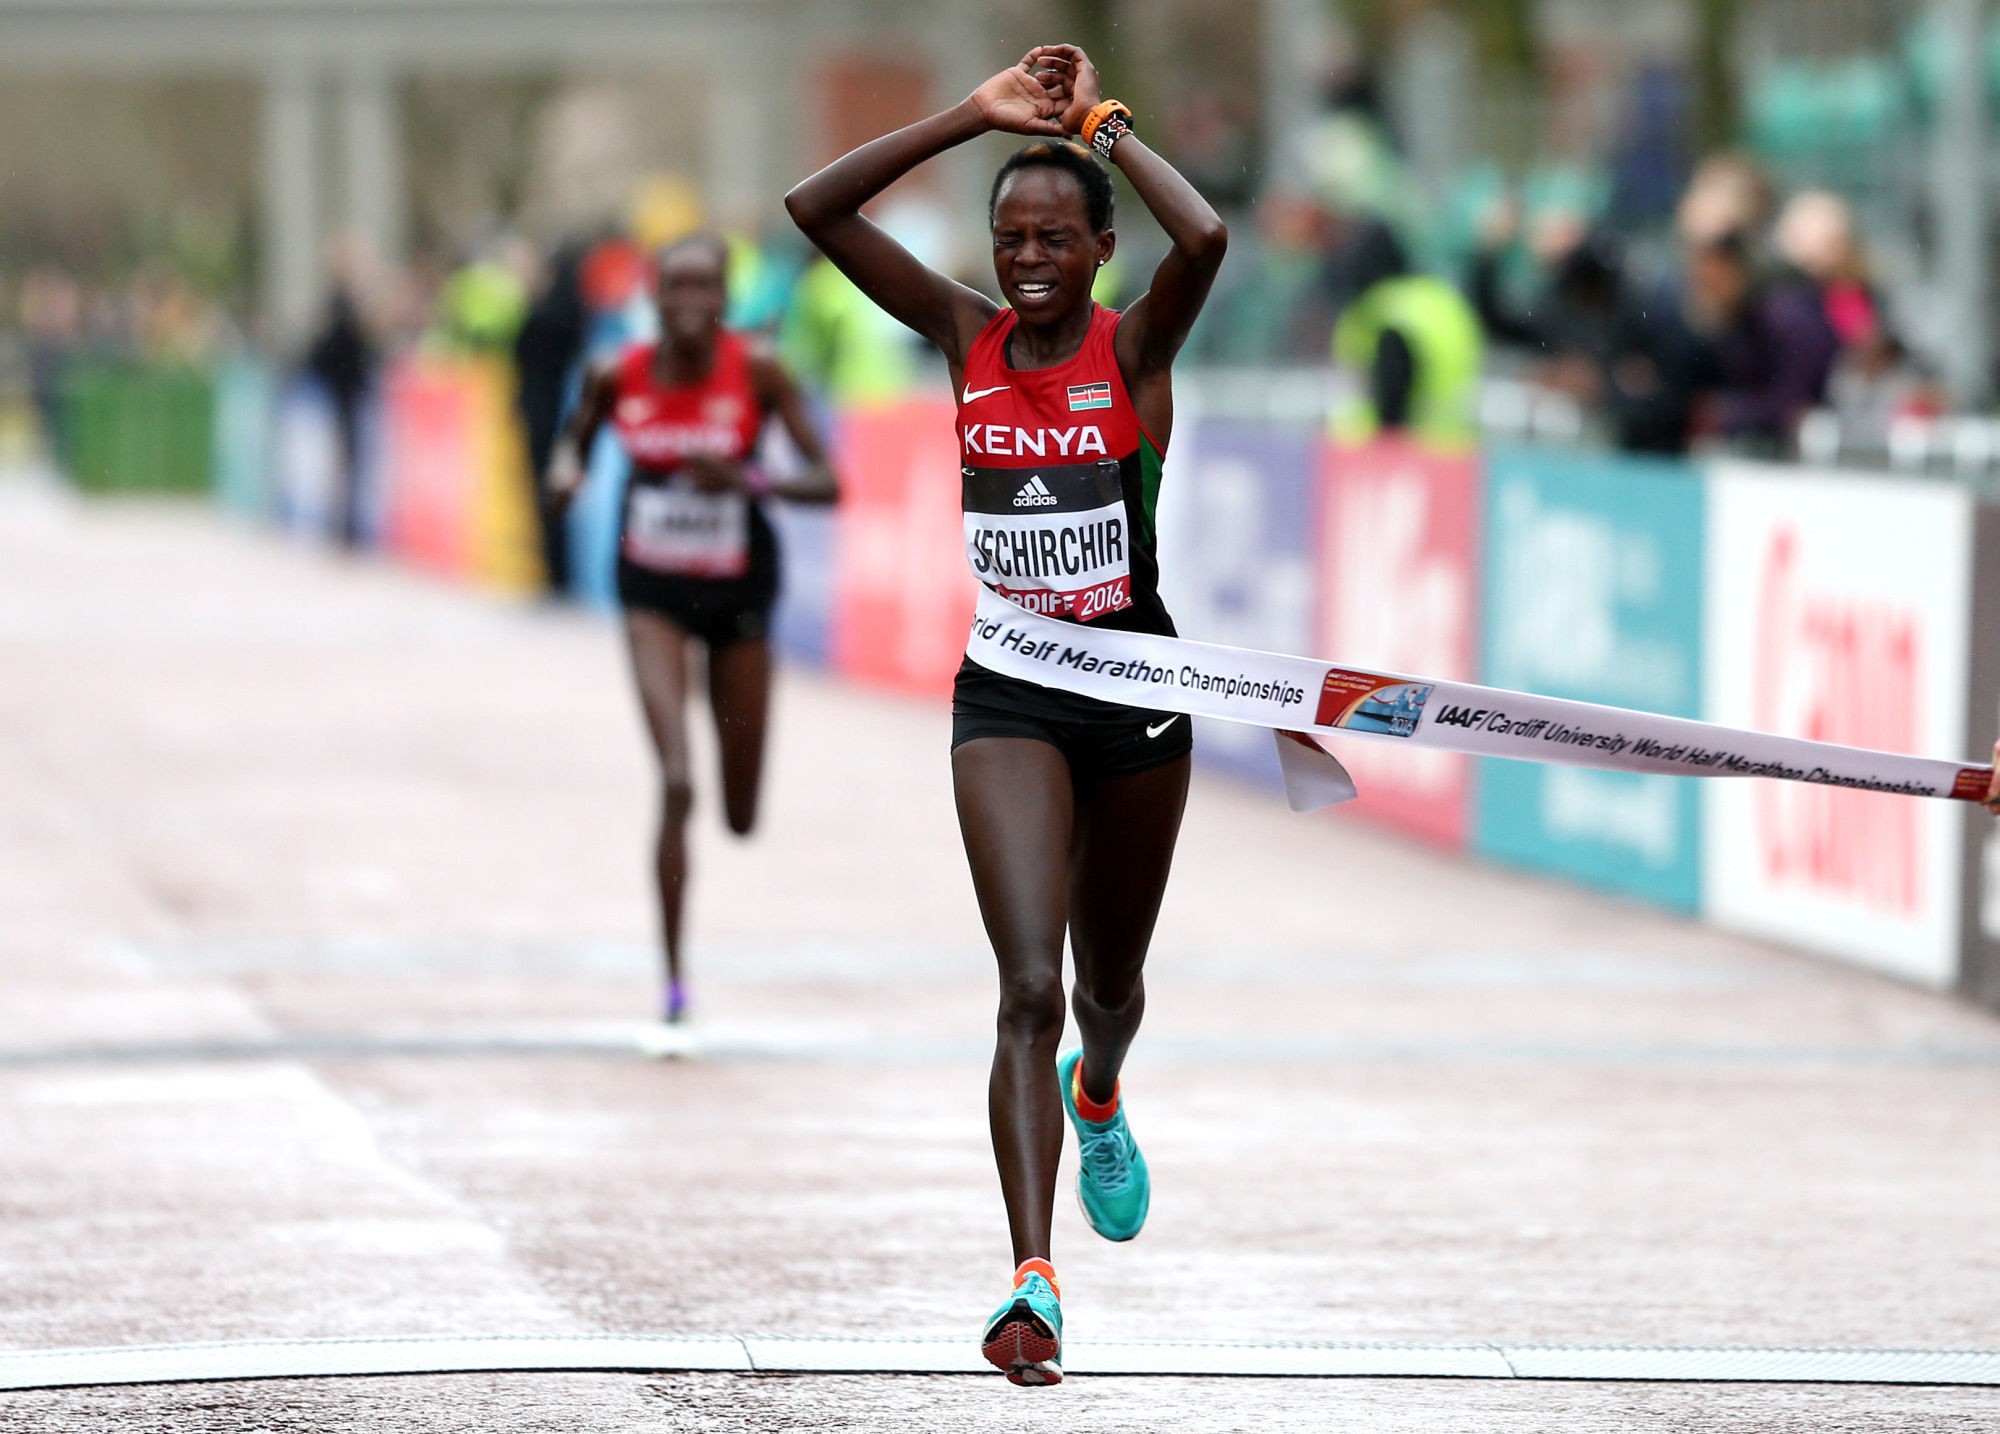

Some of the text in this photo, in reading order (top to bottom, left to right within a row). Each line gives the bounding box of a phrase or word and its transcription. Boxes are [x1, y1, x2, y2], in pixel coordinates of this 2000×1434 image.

[964, 424, 1107, 456] KENYA
[1012, 495, 1058, 507] adidas
[1080, 581, 1124, 617] 2016
[971, 614, 1304, 707] rld Half Marathon Championships
[1543, 723, 1632, 756] University
[1629, 737, 1690, 763] World
[1683, 747, 1728, 767] Half
[1717, 753, 1804, 780] Marathon
